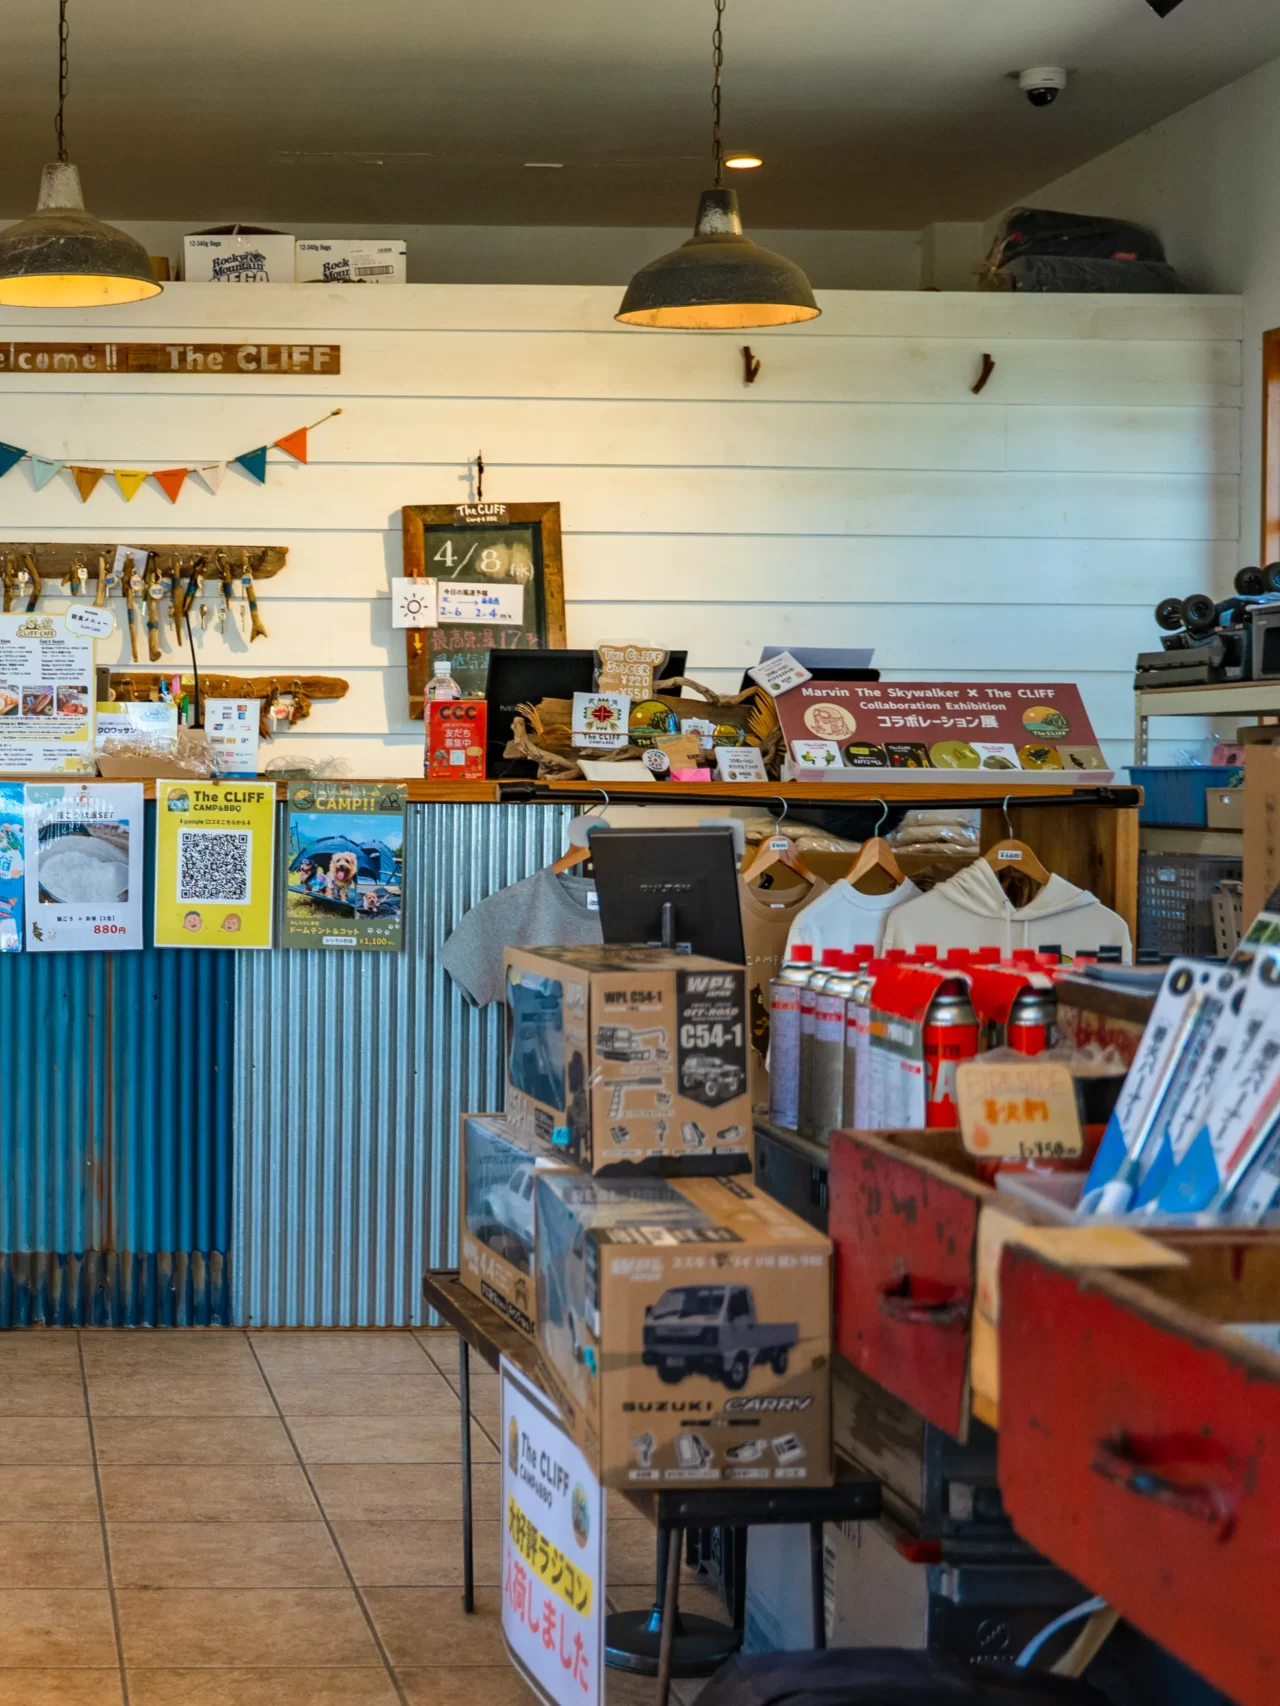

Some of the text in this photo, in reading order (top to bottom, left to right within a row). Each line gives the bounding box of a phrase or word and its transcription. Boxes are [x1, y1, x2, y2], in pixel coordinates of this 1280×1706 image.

[212, 253, 246, 268] Rocky
[322, 258, 349, 271] Rock
[212, 263, 265, 278] Mountain
[166, 345, 222, 371] The
[236, 345, 331, 372] CLIFF
[456, 503, 506, 516] The CLIFF
[621, 676, 650, 686] ¥220
[801, 687, 850, 698] Marvin
[855, 687, 881, 698] The
[888, 687, 960, 700] Skywalker
[985, 688, 1012, 699] The
[1017, 688, 1055, 699] CLIFF
[860, 700, 1006, 711] Collaboration Exhibition
[439, 705, 477, 720] CCC
[878, 714, 999, 729] コラボレーション展
[97, 727, 137, 735] クロワッサン
[445, 729, 471, 738] 友だち
[193, 790, 265, 803] The CLIFF
[193, 803, 241, 813] CAMP&BBQ
[315, 797, 375, 811] CAMP!!
[93, 924, 126, 935] 880円
[359, 937, 387, 945] ¥1,100
[686, 975, 735, 993] WPL
[604, 991, 628, 1004] WPL
[683, 1008, 739, 1017] OFF-ROAD
[680, 1023, 742, 1048] C54-1
[622, 1396, 814, 1412] SUZUKI CARRY
[522, 1431, 570, 1497] The CLIFF
[519, 1463, 553, 1510] CAMP&BBQ
